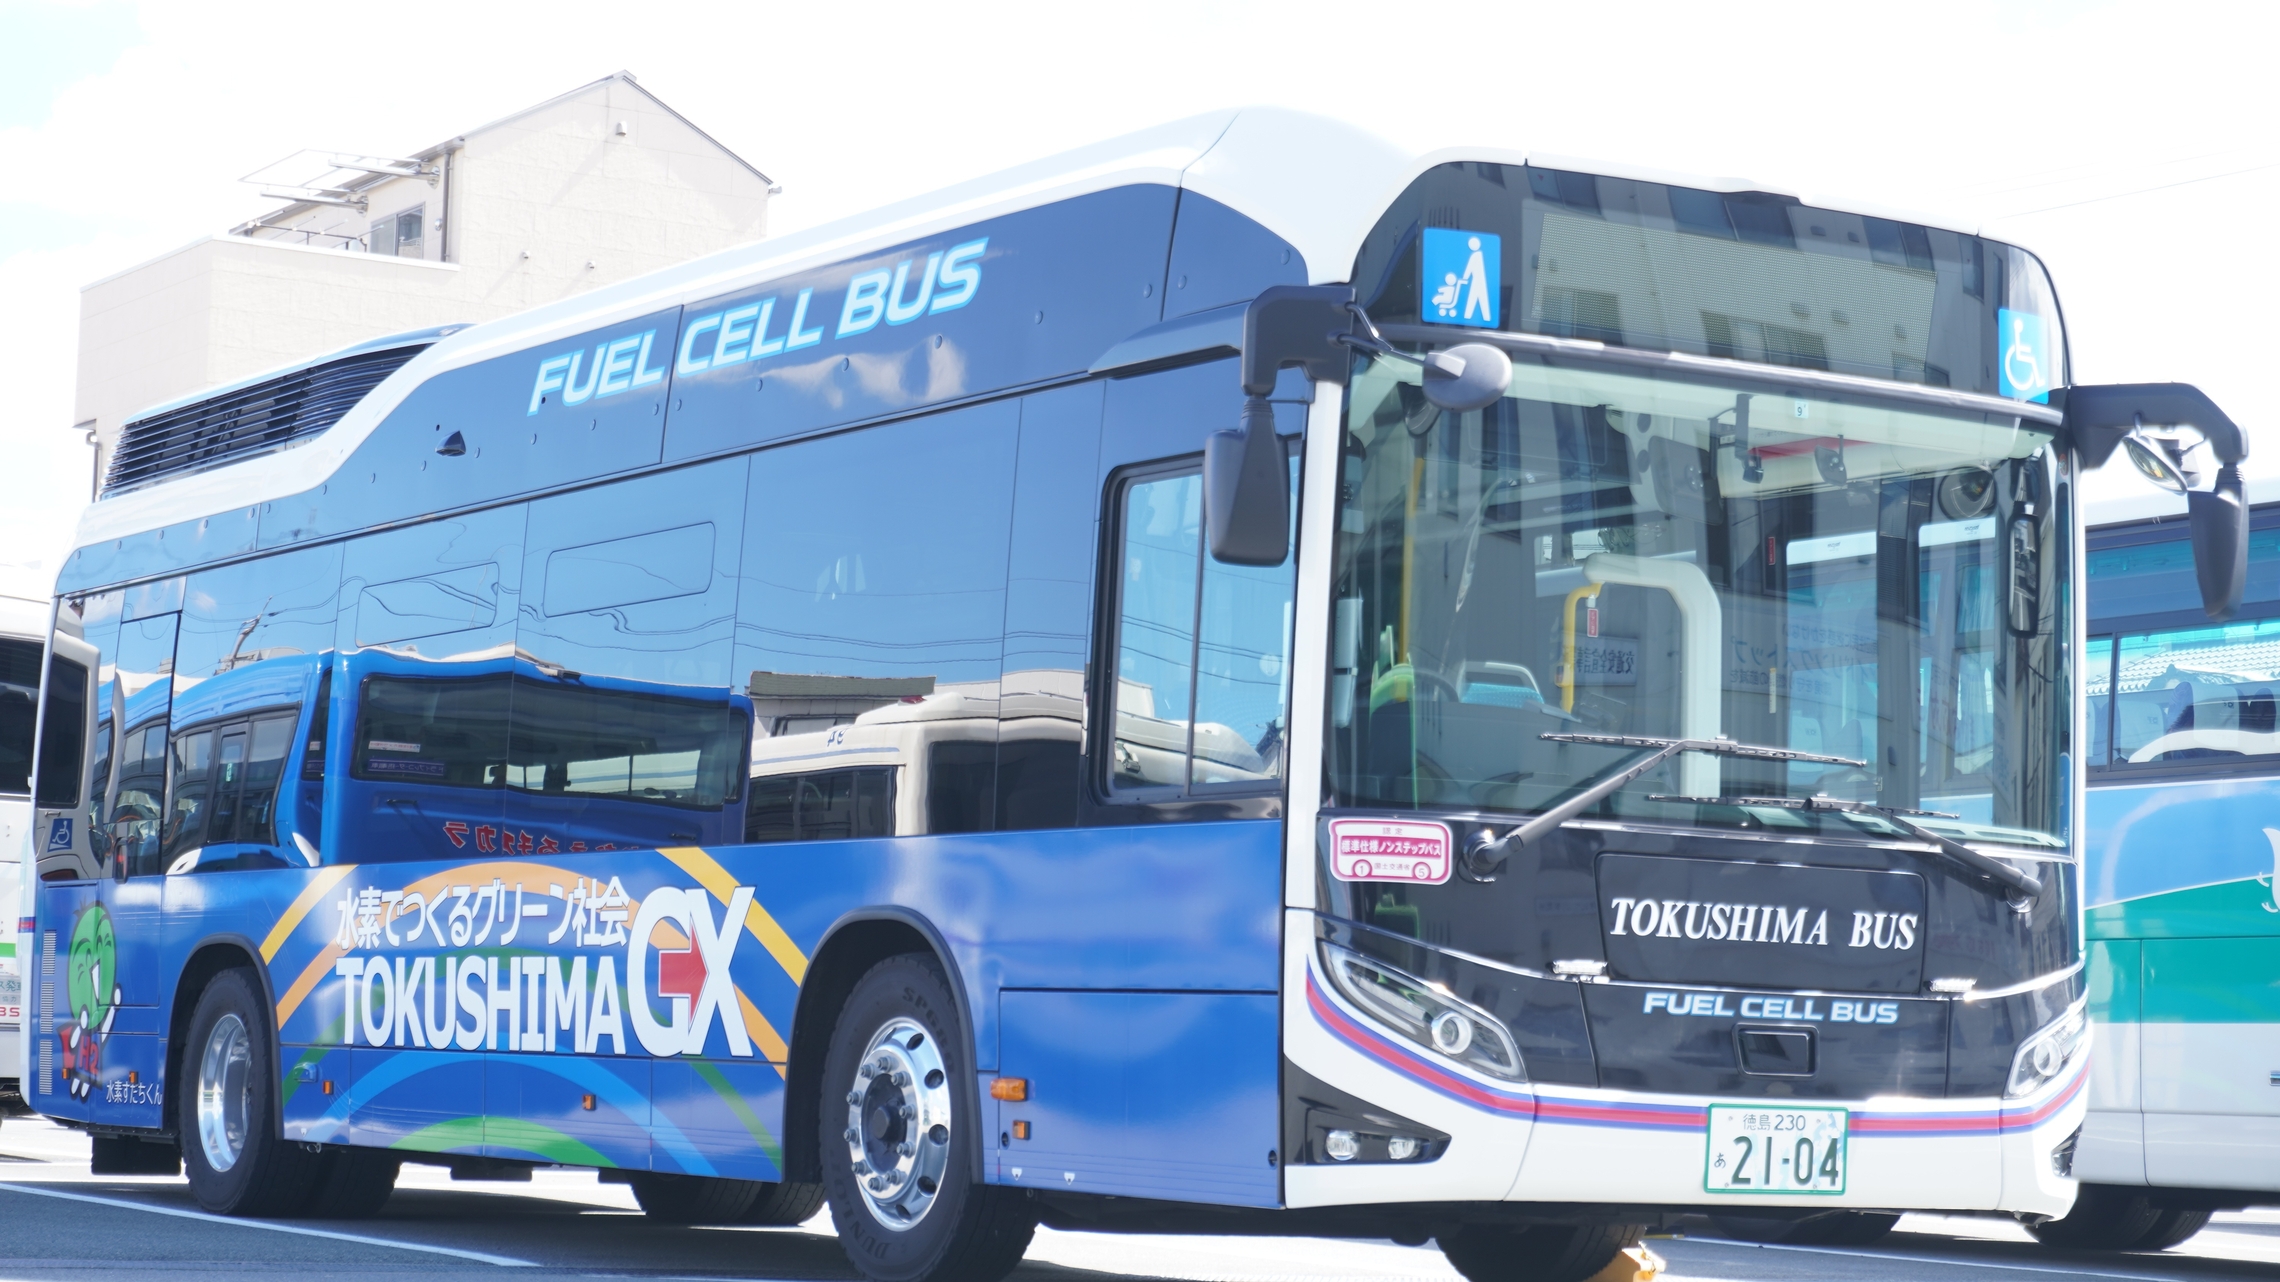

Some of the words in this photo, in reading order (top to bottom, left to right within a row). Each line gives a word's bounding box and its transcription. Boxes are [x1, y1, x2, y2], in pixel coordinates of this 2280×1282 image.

[527, 329, 665, 416] FUEL
[677, 287, 824, 378] CELL
[835, 236, 990, 340] BUS
[1341, 839, 1441, 856] 標準仕様ノンステップバス
[1374, 862, 1410, 871] 国土交通省
[335, 875, 631, 950] 水素でつくるグリーン社会
[1610, 897, 1830, 946] TOKUSHIMA
[1848, 911, 1918, 950] BUS
[335, 955, 627, 1055] TOKUSHIMA
[627, 885, 756, 1057] GX
[1643, 992, 1735, 1017] FUEL
[1740, 995, 1824, 1021] CELL
[1829, 1001, 1899, 1024] BUS
[79, 1035, 99, 1075] H2
[106, 1080, 162, 1105] 水素すだちくん
[1743, 1114, 1771, 1131] 徳島
[1774, 1114, 1806, 1131] 230
[1714, 1152, 1726, 1169] あ
[1731, 1136, 1839, 1187] 21-04
